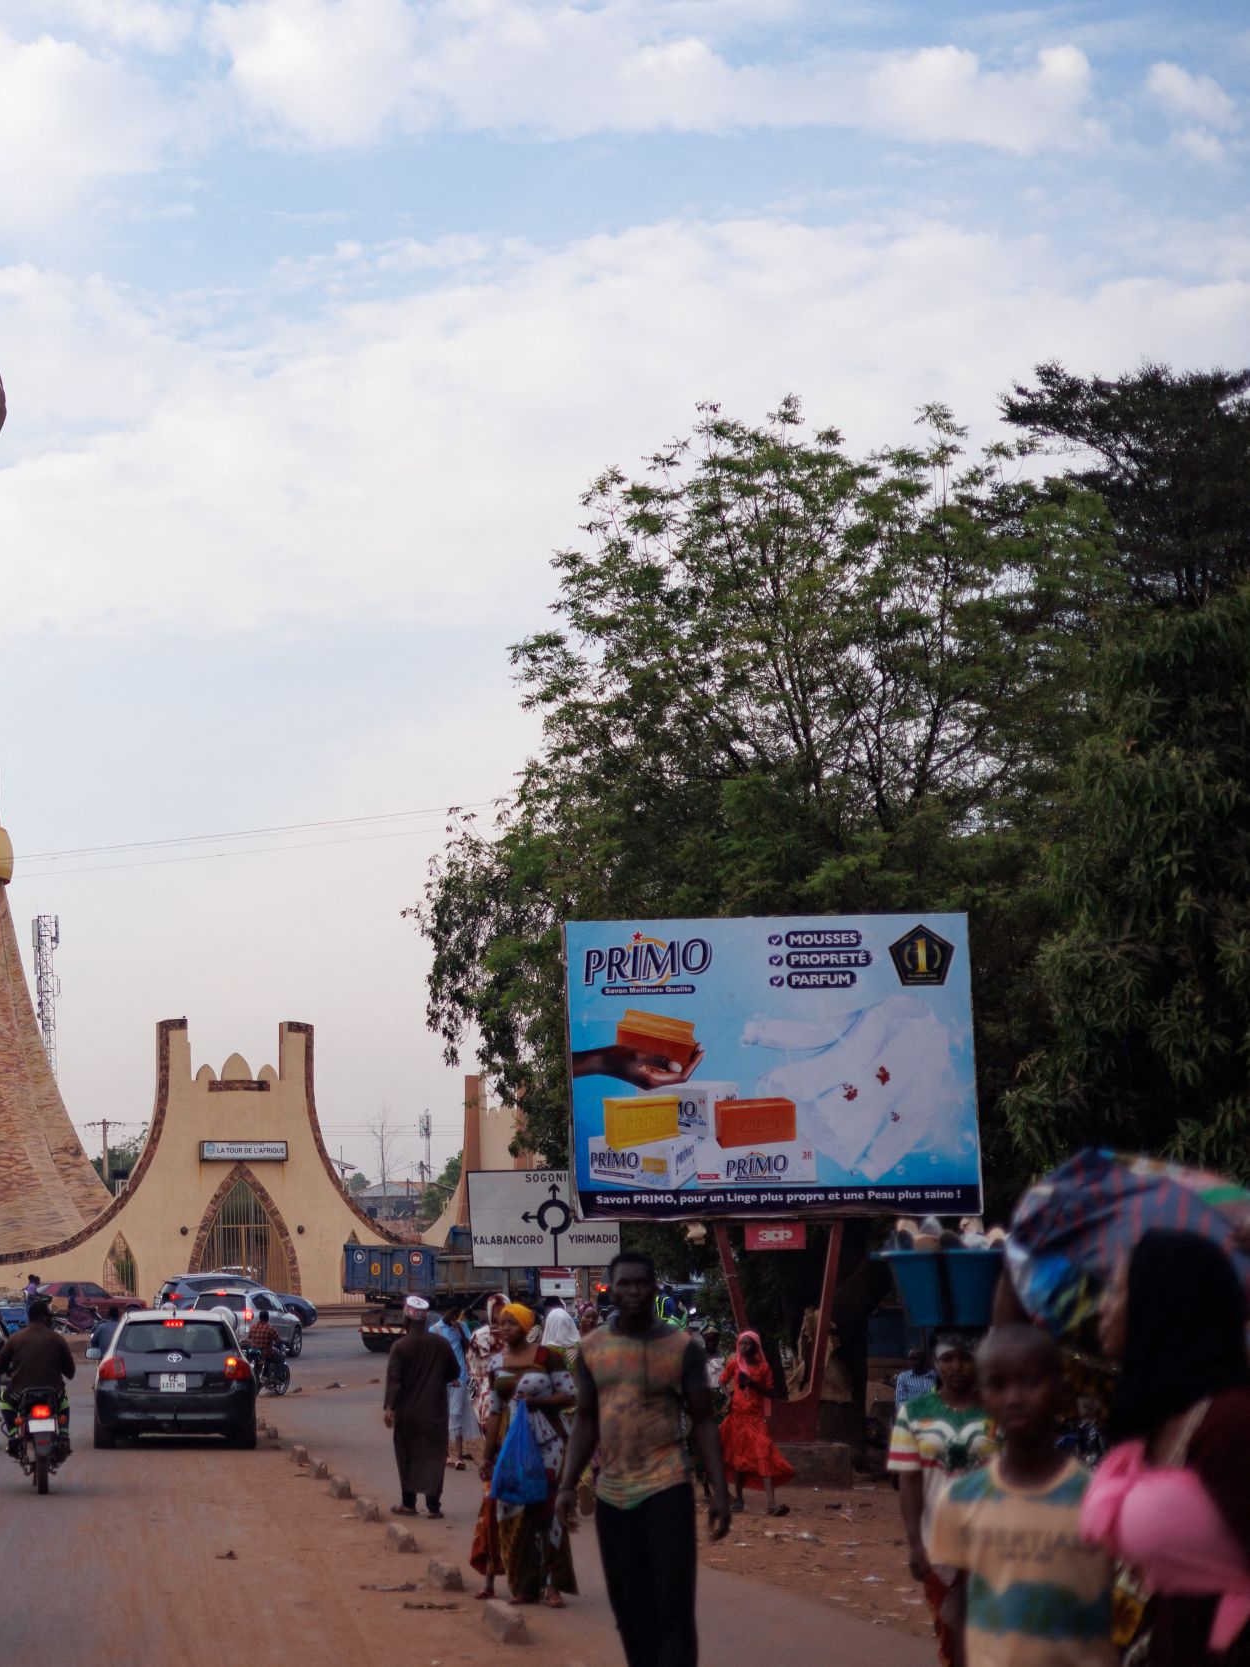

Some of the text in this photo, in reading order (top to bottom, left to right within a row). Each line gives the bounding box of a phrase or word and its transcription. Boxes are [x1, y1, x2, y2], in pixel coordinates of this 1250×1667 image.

[790, 933, 858, 946] MOUSSES
[583, 937, 712, 986] PRIMO
[790, 951, 867, 965] PROPRETÉ
[791, 974, 851, 986] PARFUM
[630, 986, 664, 994] Meilleure
[665, 985, 692, 993] Qualité
[591, 1151, 640, 1170] PRIMO
[726, 1153, 789, 1178] PRIMO
[525, 1173, 567, 1183] SOGONI
[596, 1194, 631, 1205] Savon
[633, 1194, 677, 1205] PRIMO,
[680, 1195, 707, 1206] pour
[727, 1193, 758, 1204] Linge
[760, 1192, 784, 1204] plus
[787, 1193, 825, 1204] propre
[828, 1191, 841, 1200] et
[844, 1191, 865, 1200] une
[867, 1190, 895, 1200] Peau
[898, 1189, 922, 1202] plus
[924, 1189, 954, 1199] saine
[473, 1234, 619, 1245] KALABANCORO YIRIMADIO
